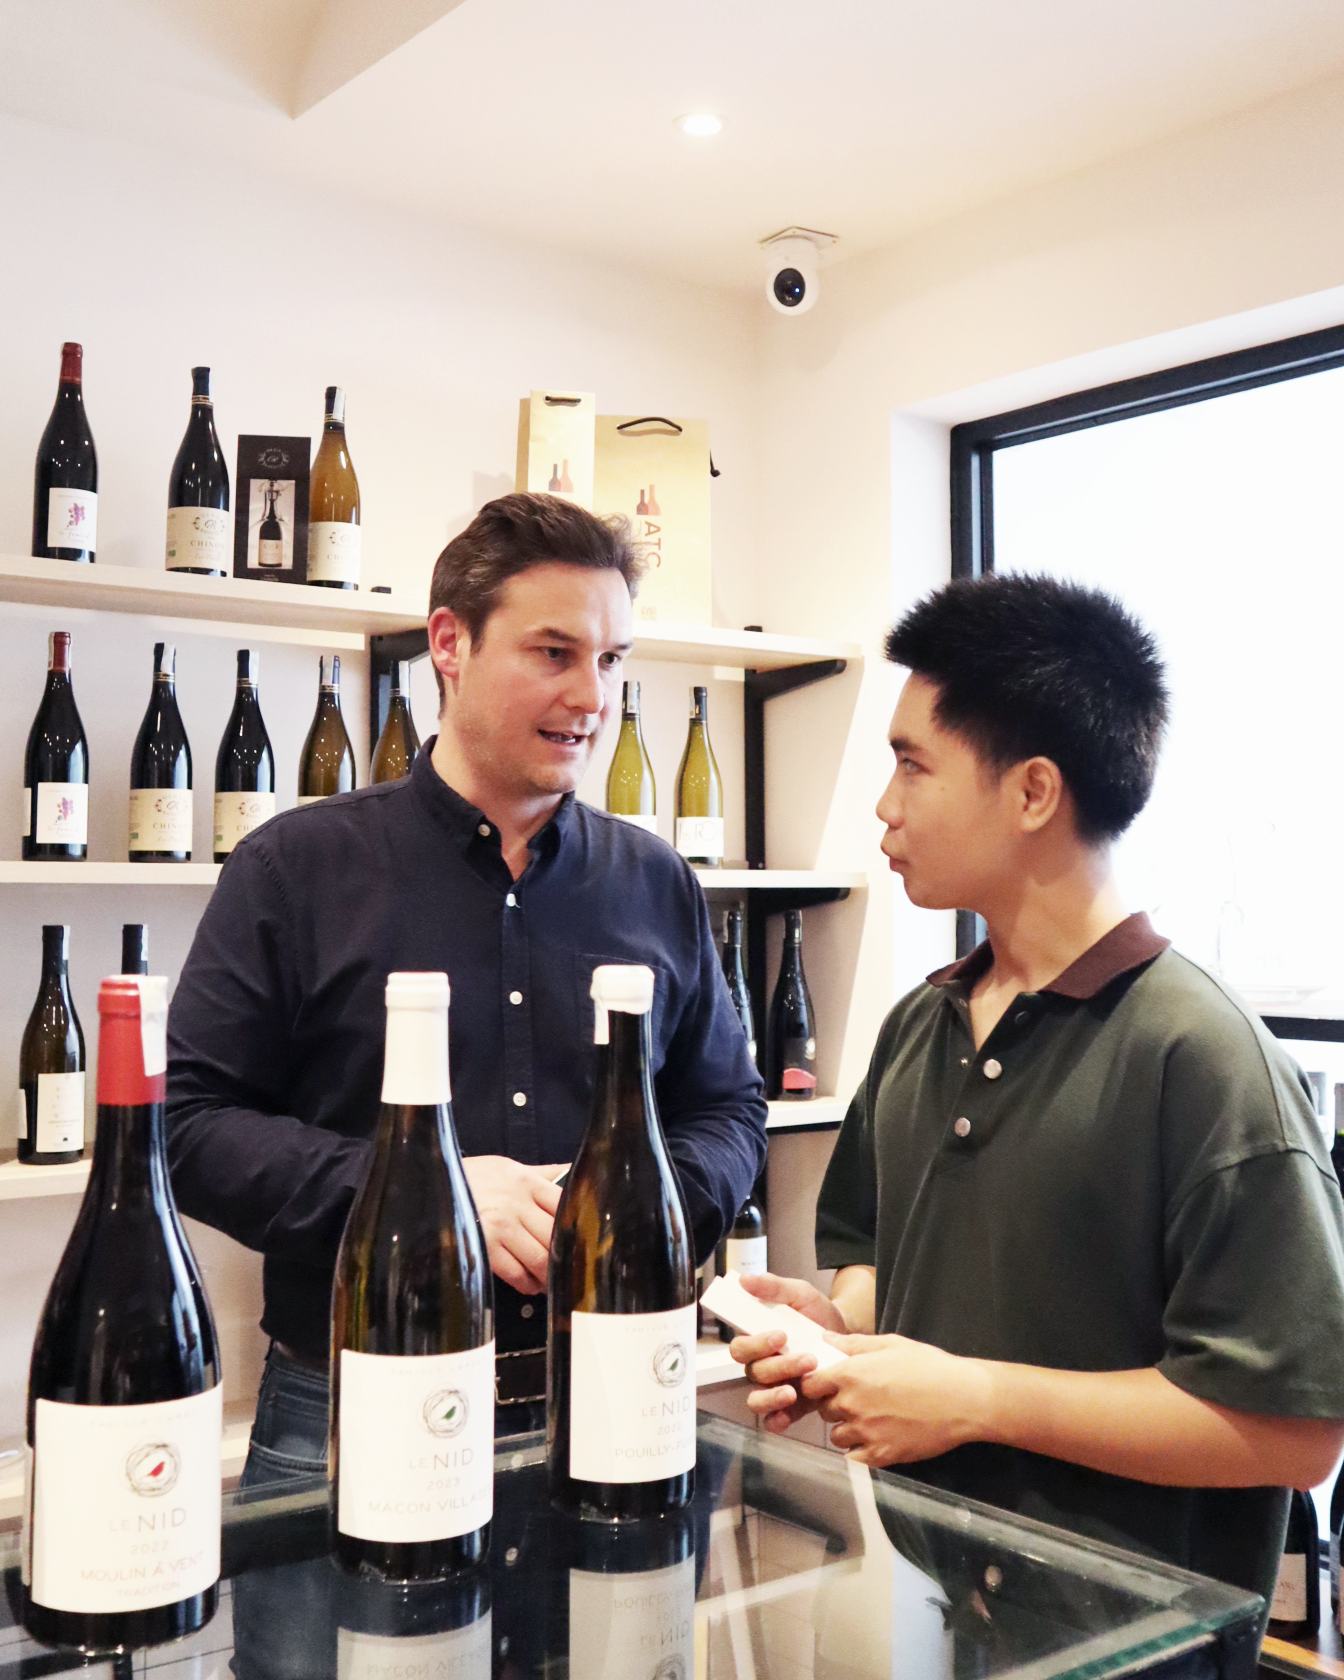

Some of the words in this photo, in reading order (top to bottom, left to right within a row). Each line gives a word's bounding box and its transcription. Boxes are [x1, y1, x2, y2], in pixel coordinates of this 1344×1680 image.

[642, 1406, 657, 1417] LE
[662, 1396, 691, 1417] NID
[657, 1422, 682, 1436] 2022
[409, 1457, 427, 1469] LE
[433, 1448, 474, 1471] NID
[427, 1477, 460, 1490] 2023
[110, 1519, 130, 1532] LE
[138, 1507, 187, 1533] NID
[131, 1540, 169, 1556] 2022
[80, 1567, 146, 1582] MOULIN
[168, 1551, 205, 1572] VENT
